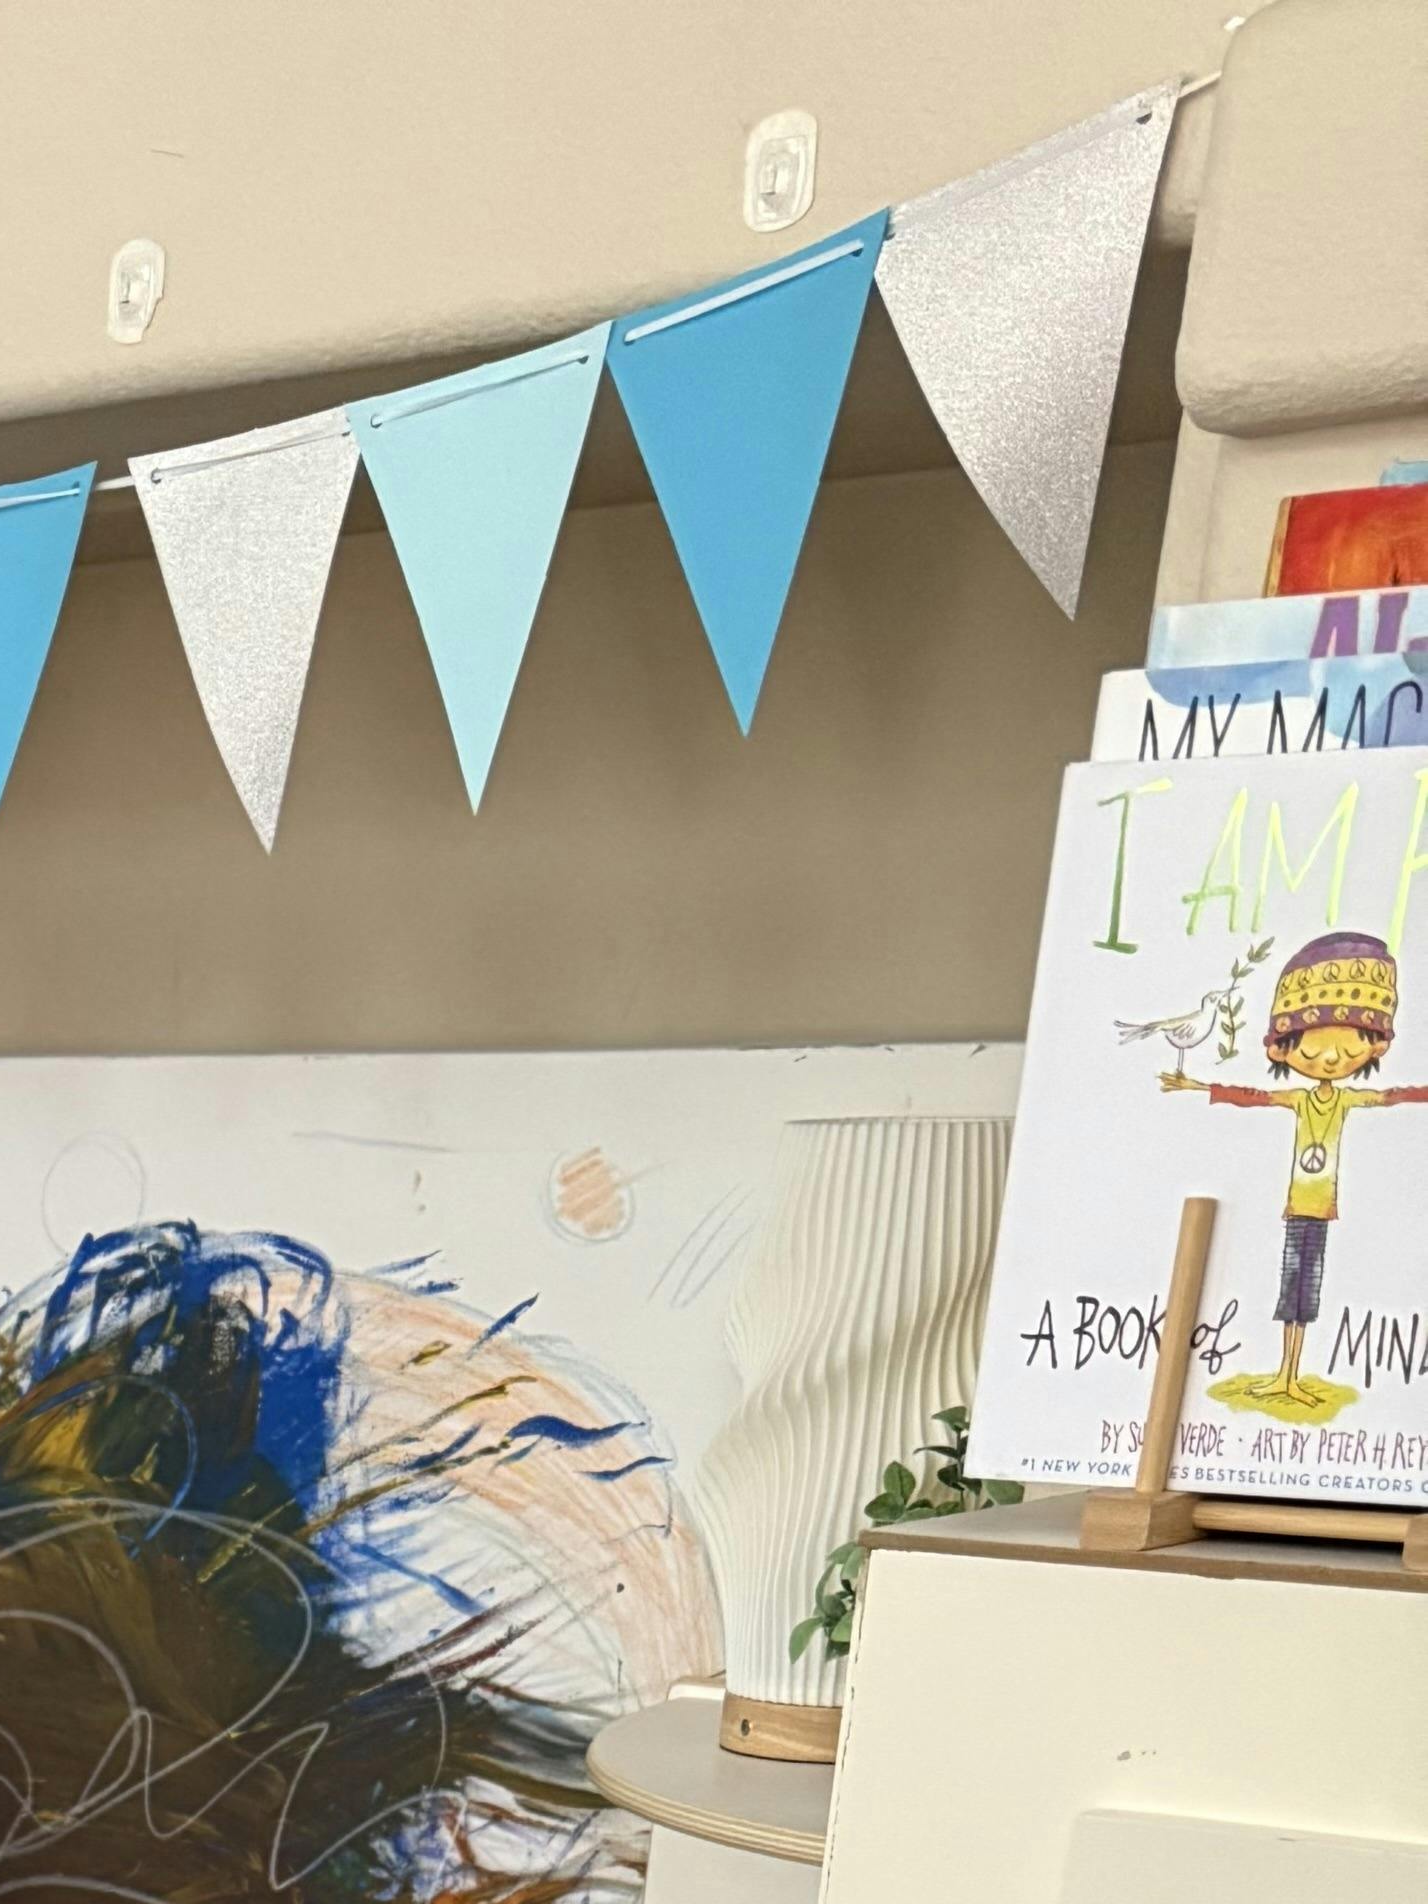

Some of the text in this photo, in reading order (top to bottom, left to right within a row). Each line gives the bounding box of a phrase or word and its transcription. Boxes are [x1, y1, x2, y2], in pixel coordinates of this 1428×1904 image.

[1092, 778, 1174, 954] I
[1181, 780, 1359, 936] AM
[1020, 1299, 1058, 1369] A
[1073, 1294, 1170, 1370] BOOK
[1190, 1299, 1243, 1375] of
[1101, 1420, 1124, 1453] BY
[1180, 1422, 1226, 1457] VERDE
[1251, 1428, 1287, 1463] ART
[1289, 1430, 1311, 1464] BY
[1318, 1428, 1367, 1465] PETER
[1021, 1458, 1036, 1471] #1
[1042, 1459, 1081, 1472] NEW
[1087, 1462, 1132, 1476] YORK
[1195, 1467, 1311, 1487] BESTSELLING
[1318, 1474, 1412, 1493] CREATORS
